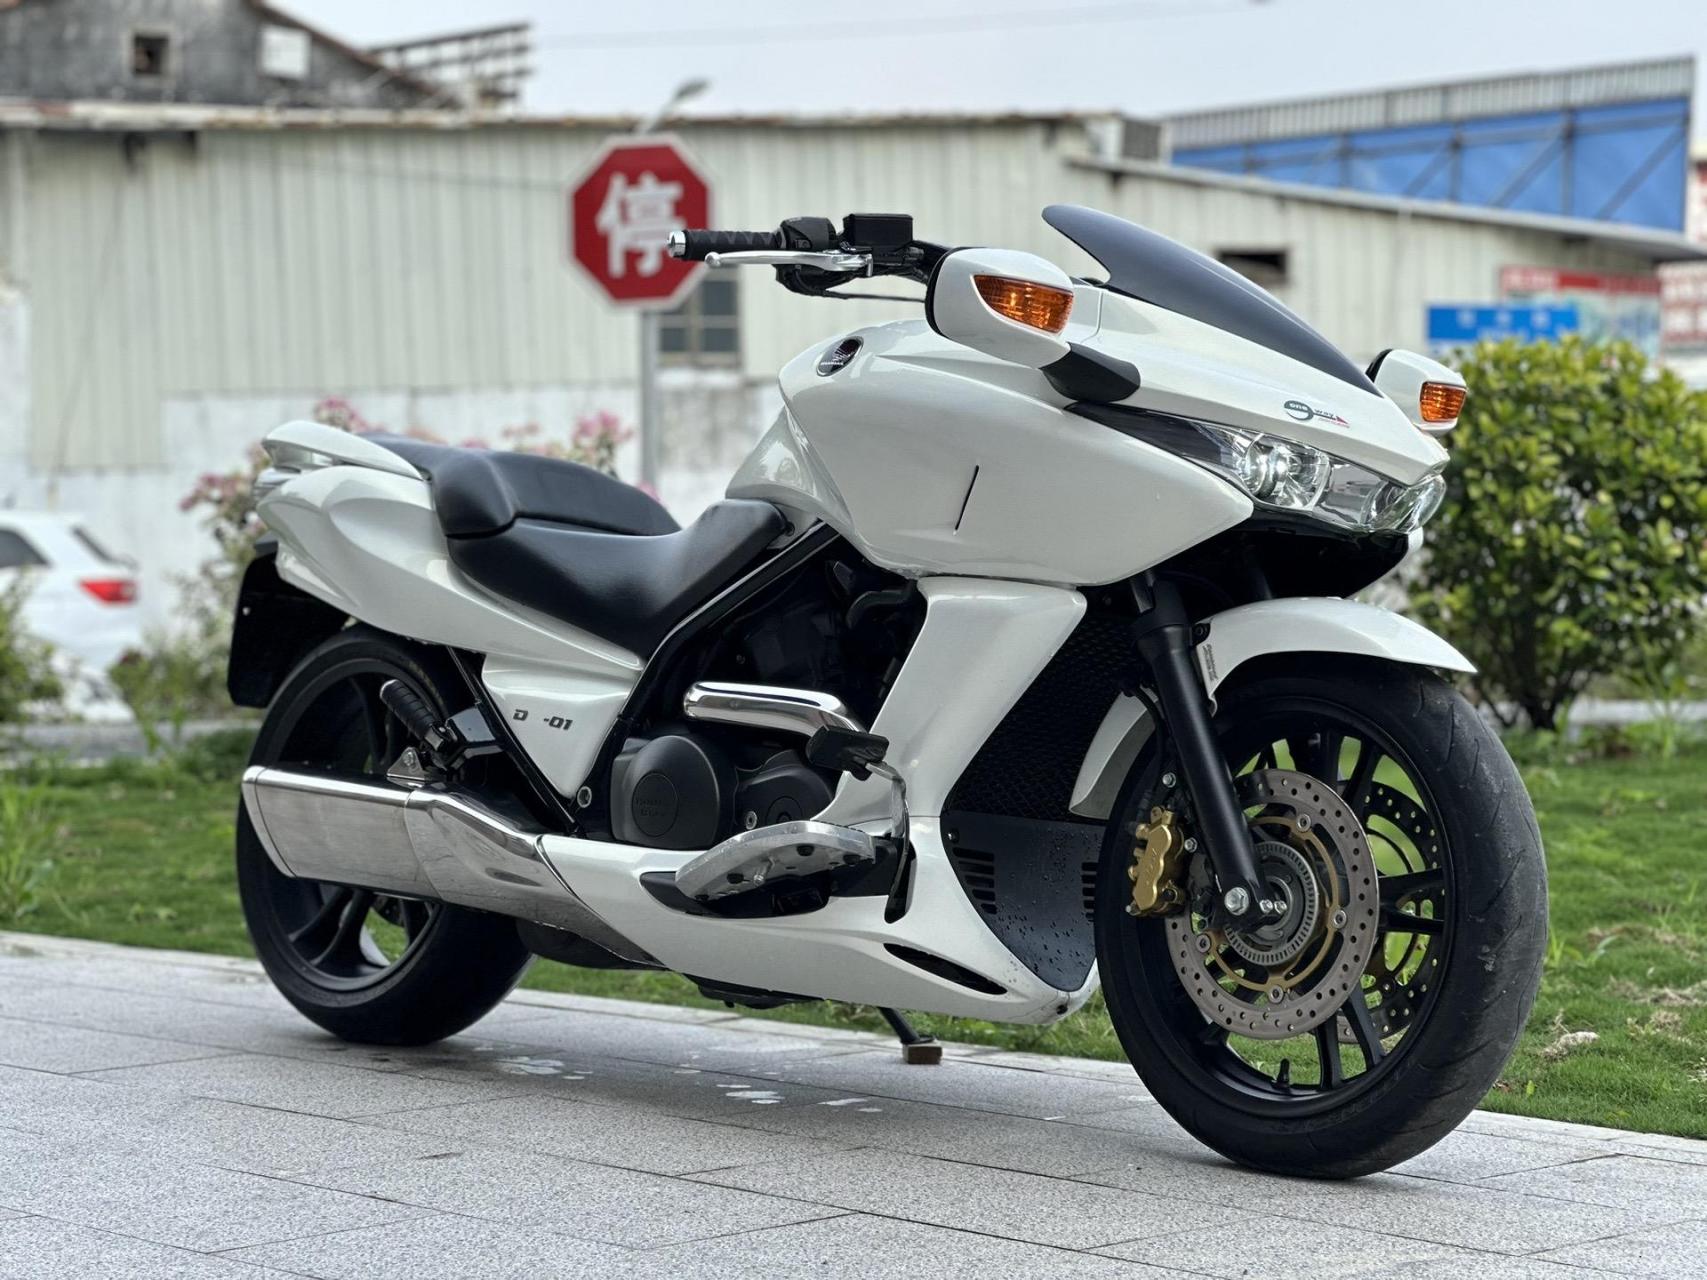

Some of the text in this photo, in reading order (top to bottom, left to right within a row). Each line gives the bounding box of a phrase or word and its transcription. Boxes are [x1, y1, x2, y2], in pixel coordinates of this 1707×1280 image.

[595, 172, 686, 278] 停
[512, 709, 573, 730] D -01
